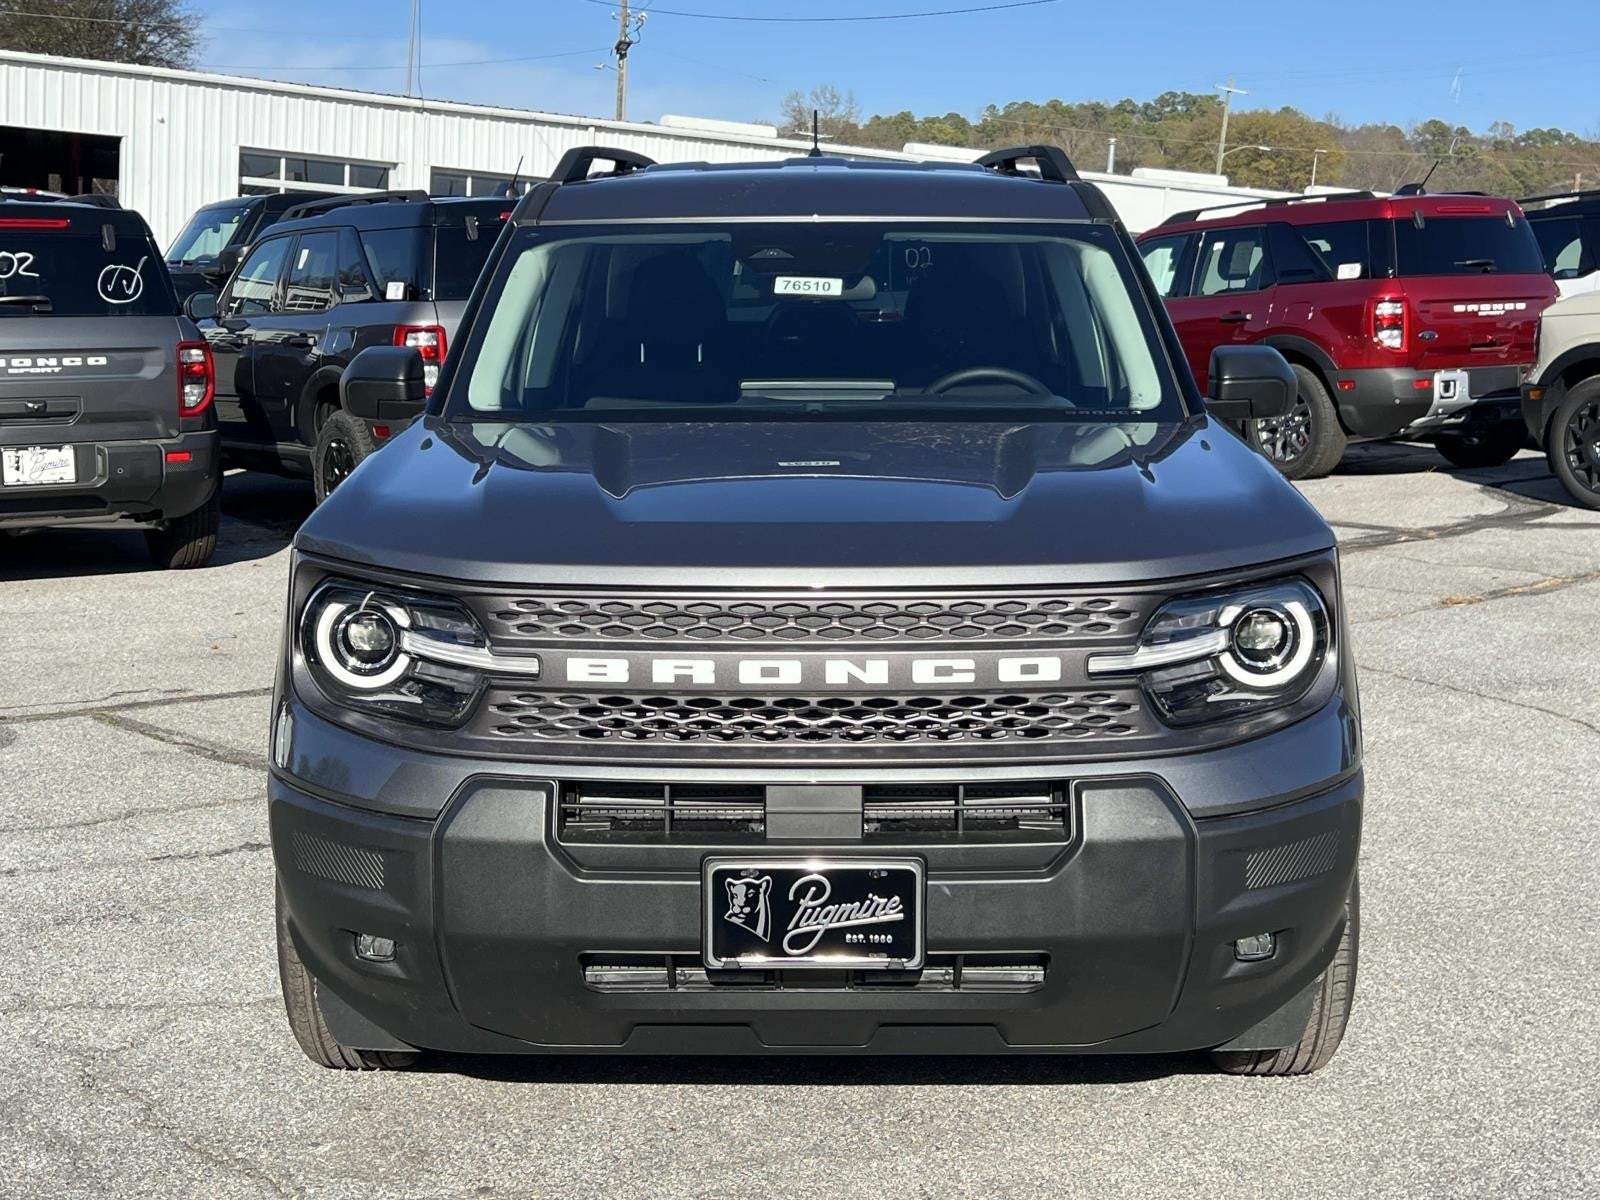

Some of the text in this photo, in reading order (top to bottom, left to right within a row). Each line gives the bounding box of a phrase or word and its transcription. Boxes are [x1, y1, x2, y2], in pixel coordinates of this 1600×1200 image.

[782, 279, 832, 292] 76510
[1453, 302, 1526, 313] BRONCO
[566, 657, 1062, 685] BRONCO
[783, 873, 905, 956] Pugmire
[845, 933, 867, 944] EST.
